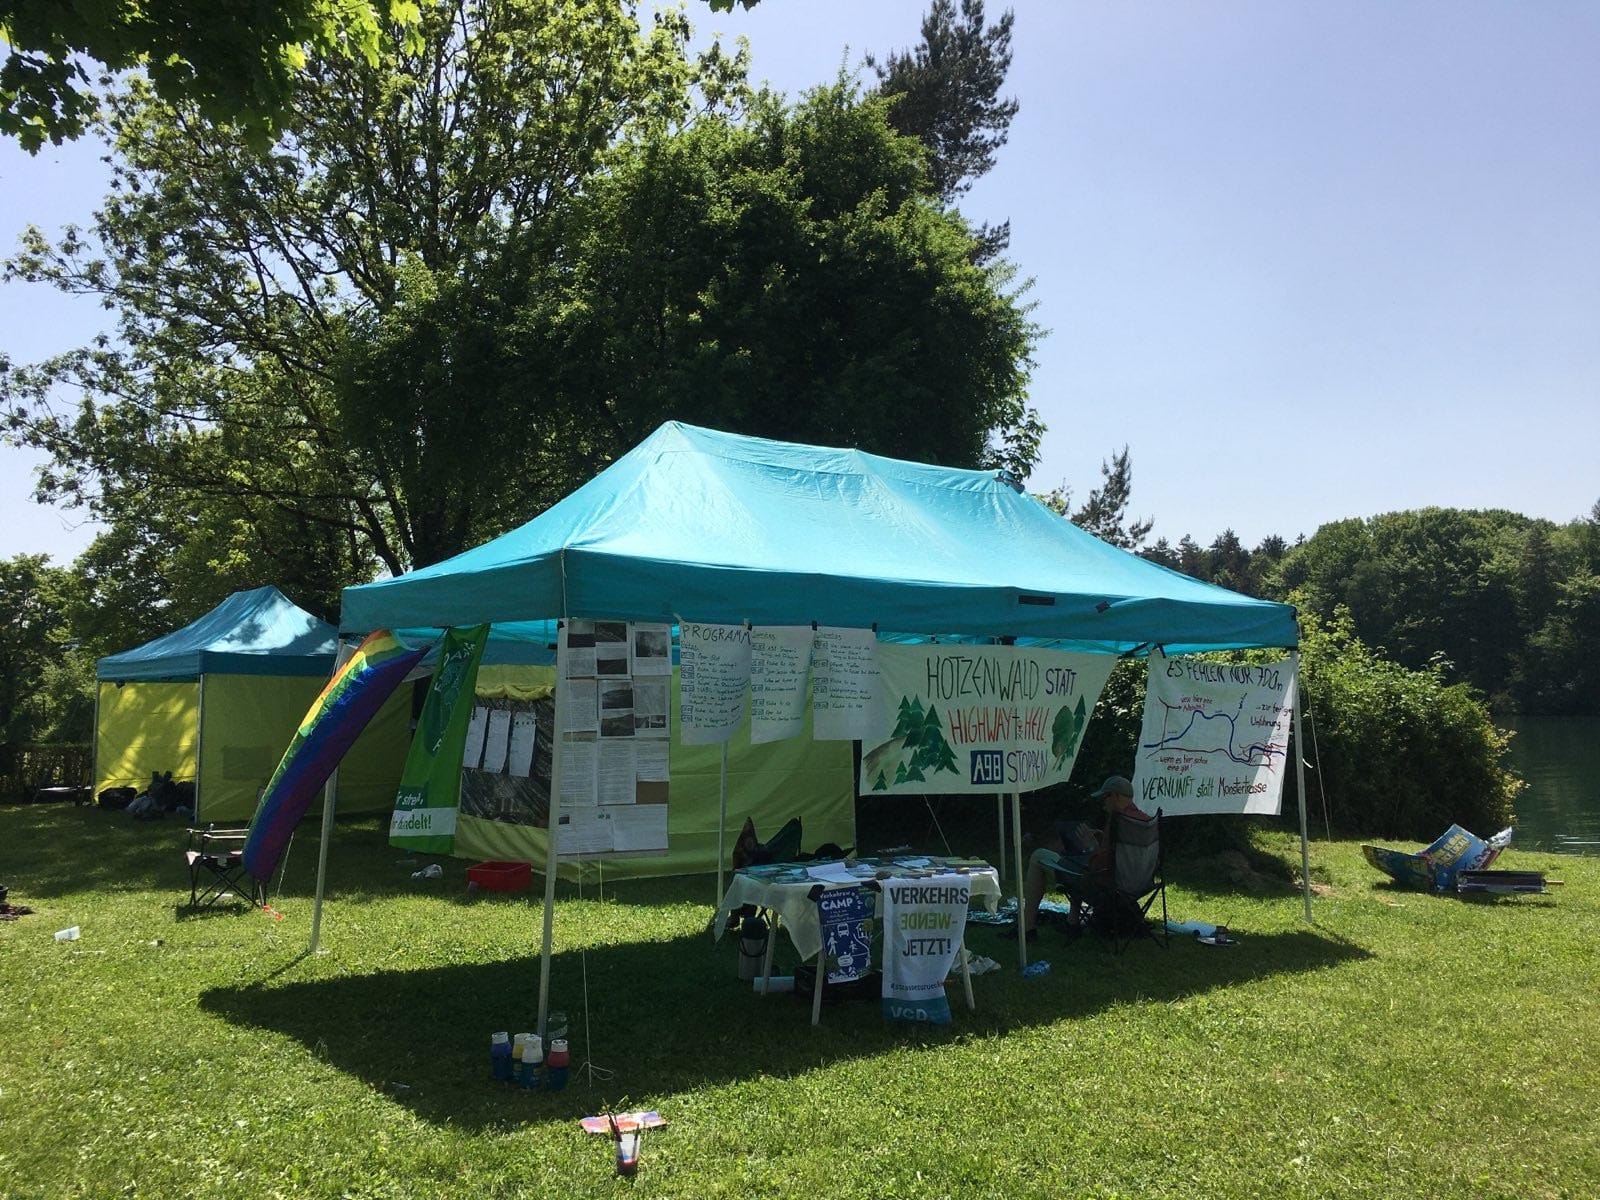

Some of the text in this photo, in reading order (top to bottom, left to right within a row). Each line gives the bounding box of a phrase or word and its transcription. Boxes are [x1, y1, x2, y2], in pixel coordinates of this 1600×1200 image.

[682, 624, 750, 645] PROGRAMM
[927, 656, 1077, 701] HOTZENWALD STATT
[1166, 660, 1183, 677] ES
[1185, 664, 1226, 682] FEHLEN
[1230, 666, 1254, 685] NUR
[948, 706, 1010, 745] HIGHWAY
[973, 750, 1048, 783] A98 STOPPEN
[1142, 775, 1267, 800] VERNUNFT statt Monstertrasse
[821, 898, 853, 911] CAMP
[889, 887, 969, 905] VERKEHRS
[902, 938, 951, 956] JETZT!
[890, 1006, 928, 1021] VCD
